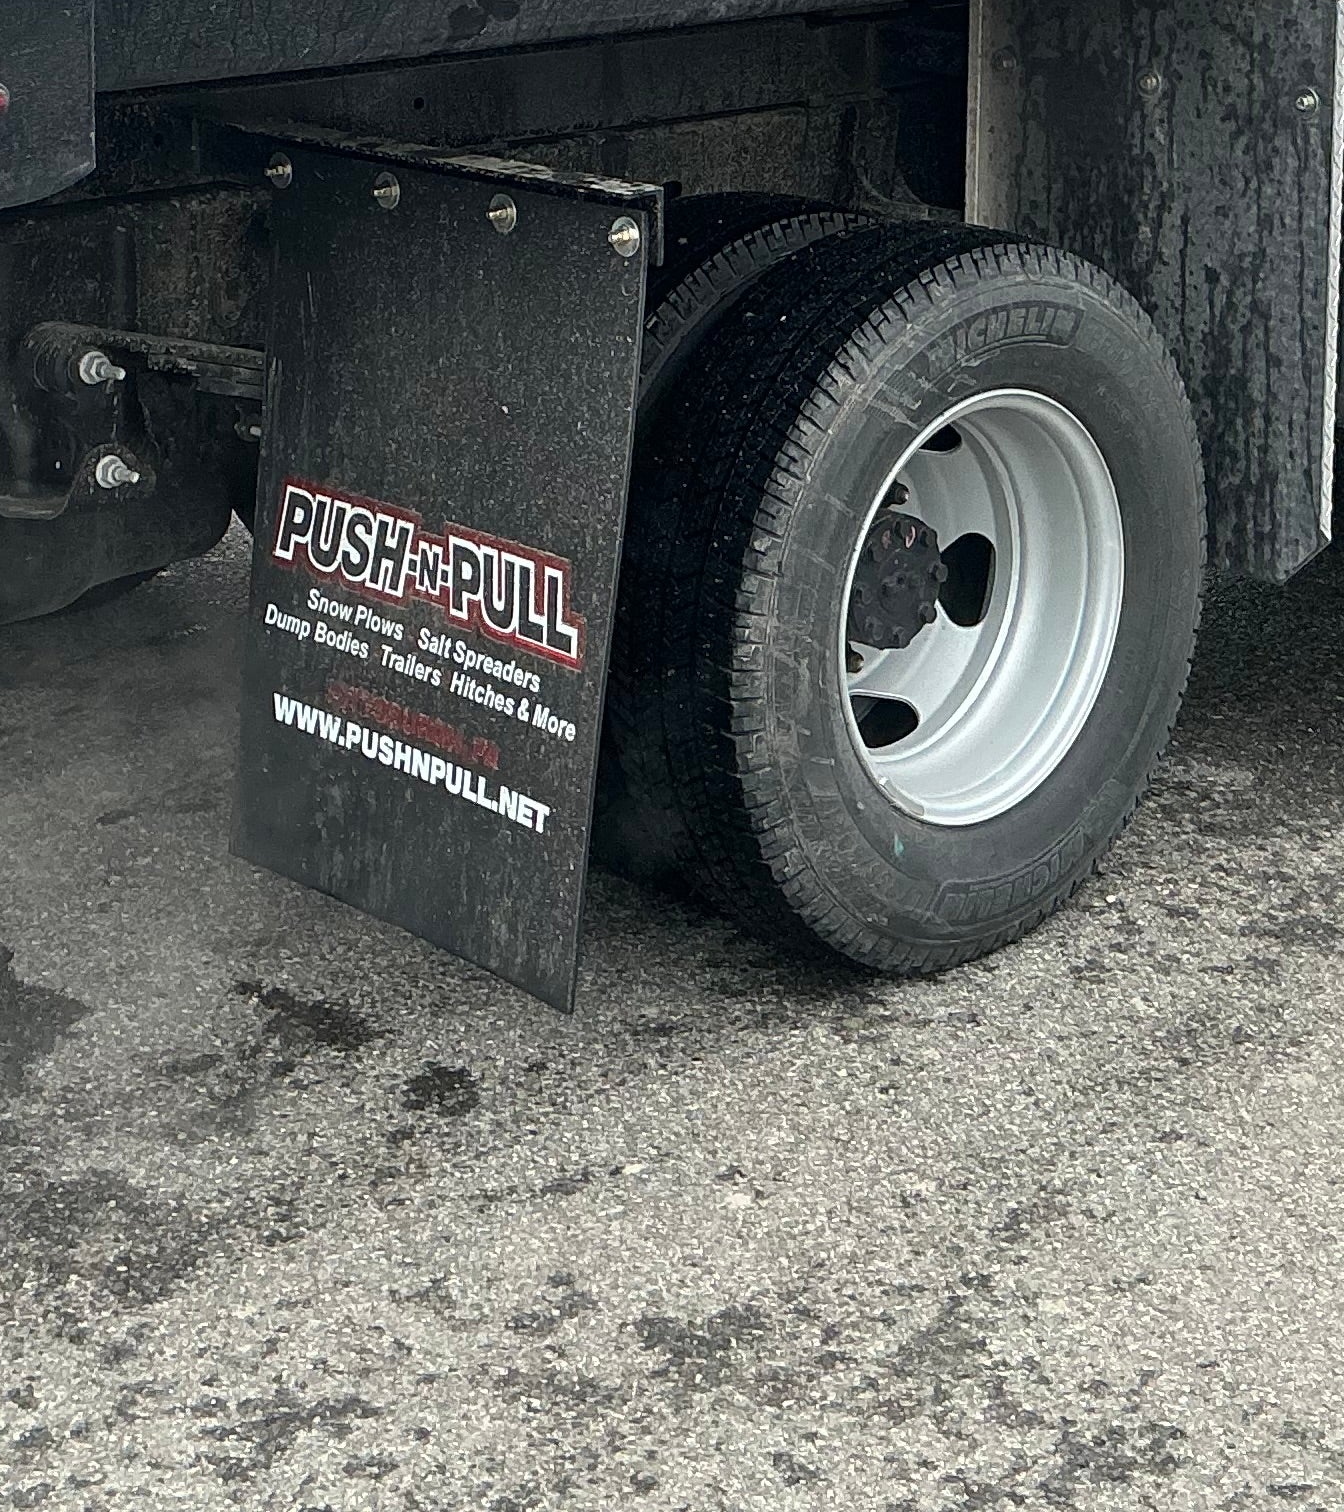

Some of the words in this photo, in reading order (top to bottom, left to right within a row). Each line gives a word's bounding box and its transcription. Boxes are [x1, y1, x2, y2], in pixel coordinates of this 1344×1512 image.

[264, 603, 311, 640] Dump
[313, 620, 370, 659] Bodies
[380, 643, 443, 687] Trailers
[449, 671, 516, 716] Hitches
[516, 697, 531, 723] &
[531, 703, 577, 742] More
[306, 587, 354, 622] Snow
[354, 604, 405, 641] Plows
[417, 627, 453, 659] Salt
[452, 639, 541, 693] Spreaders
[273, 691, 551, 834] WWW.PUSHNPULL.NET
